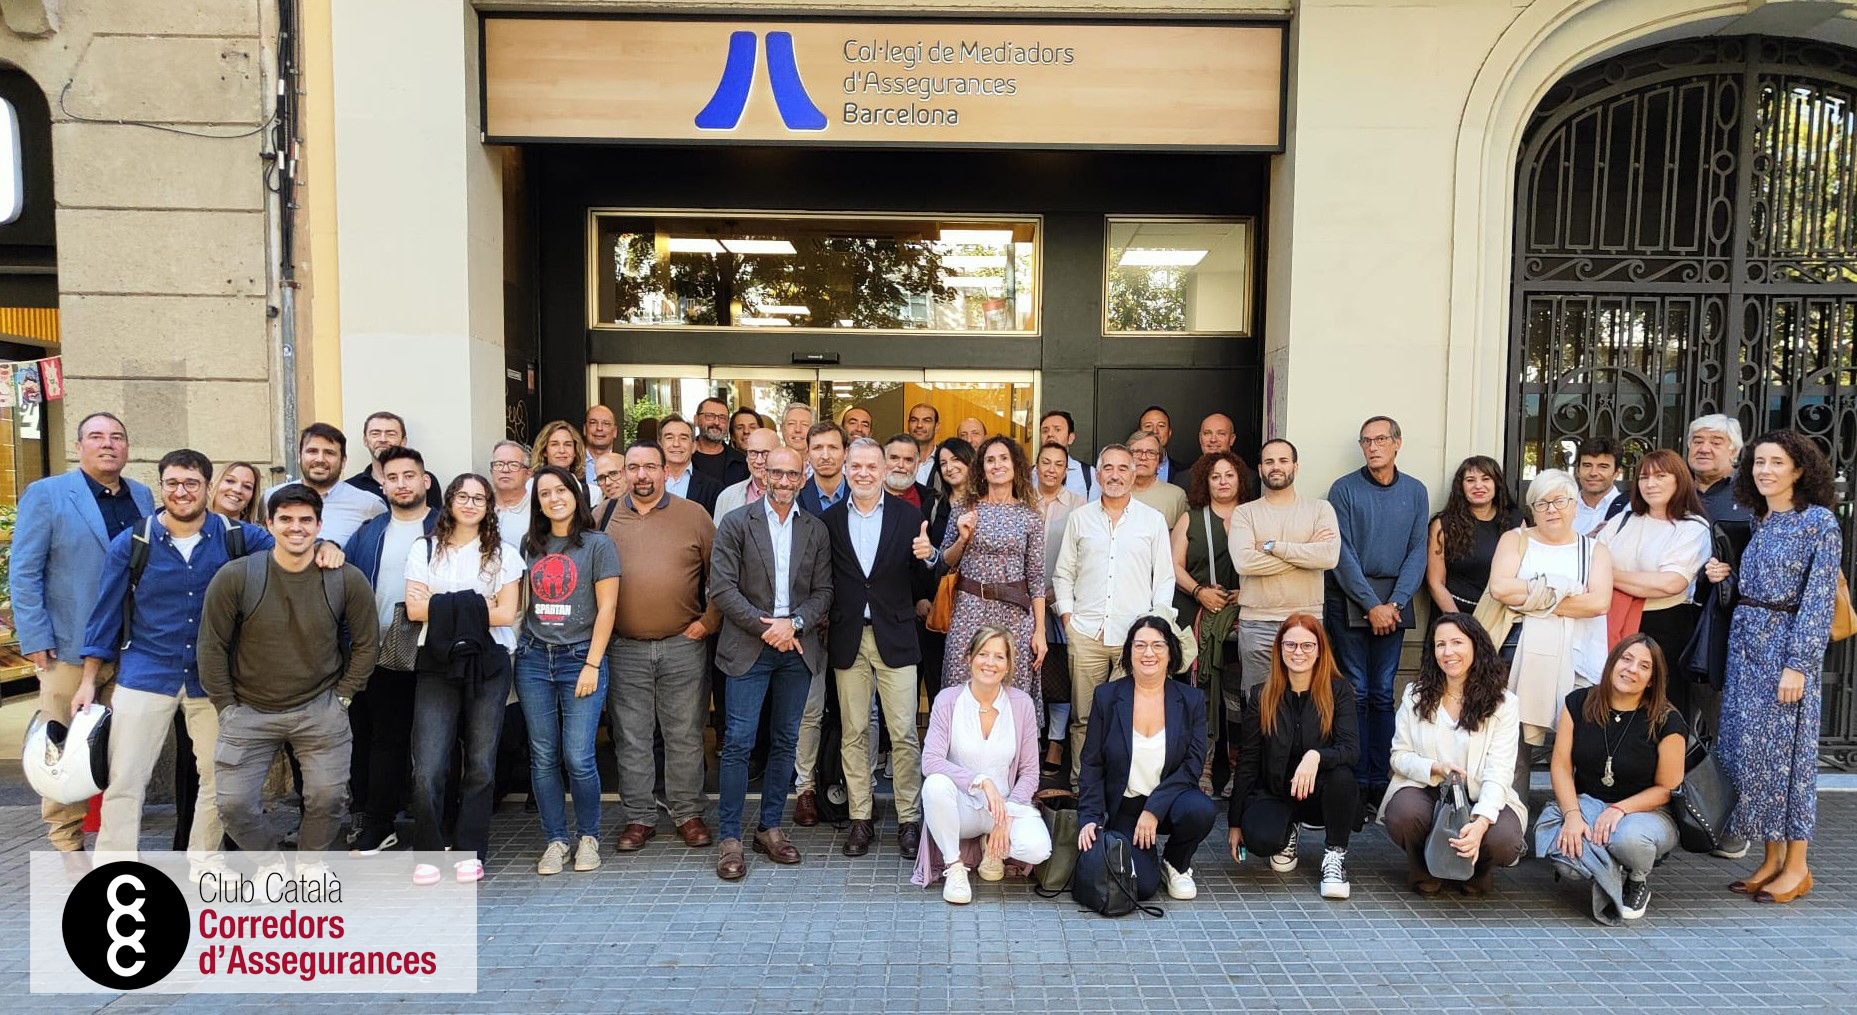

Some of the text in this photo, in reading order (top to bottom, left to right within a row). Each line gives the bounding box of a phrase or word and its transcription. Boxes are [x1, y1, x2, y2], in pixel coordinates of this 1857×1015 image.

[928, 40, 955, 63] de
[960, 40, 1075, 65] Mediadors
[843, 70, 1018, 100] d'Assegurances
[843, 102, 959, 126] Barcelona
[535, 603, 572, 616] SPARTAN
